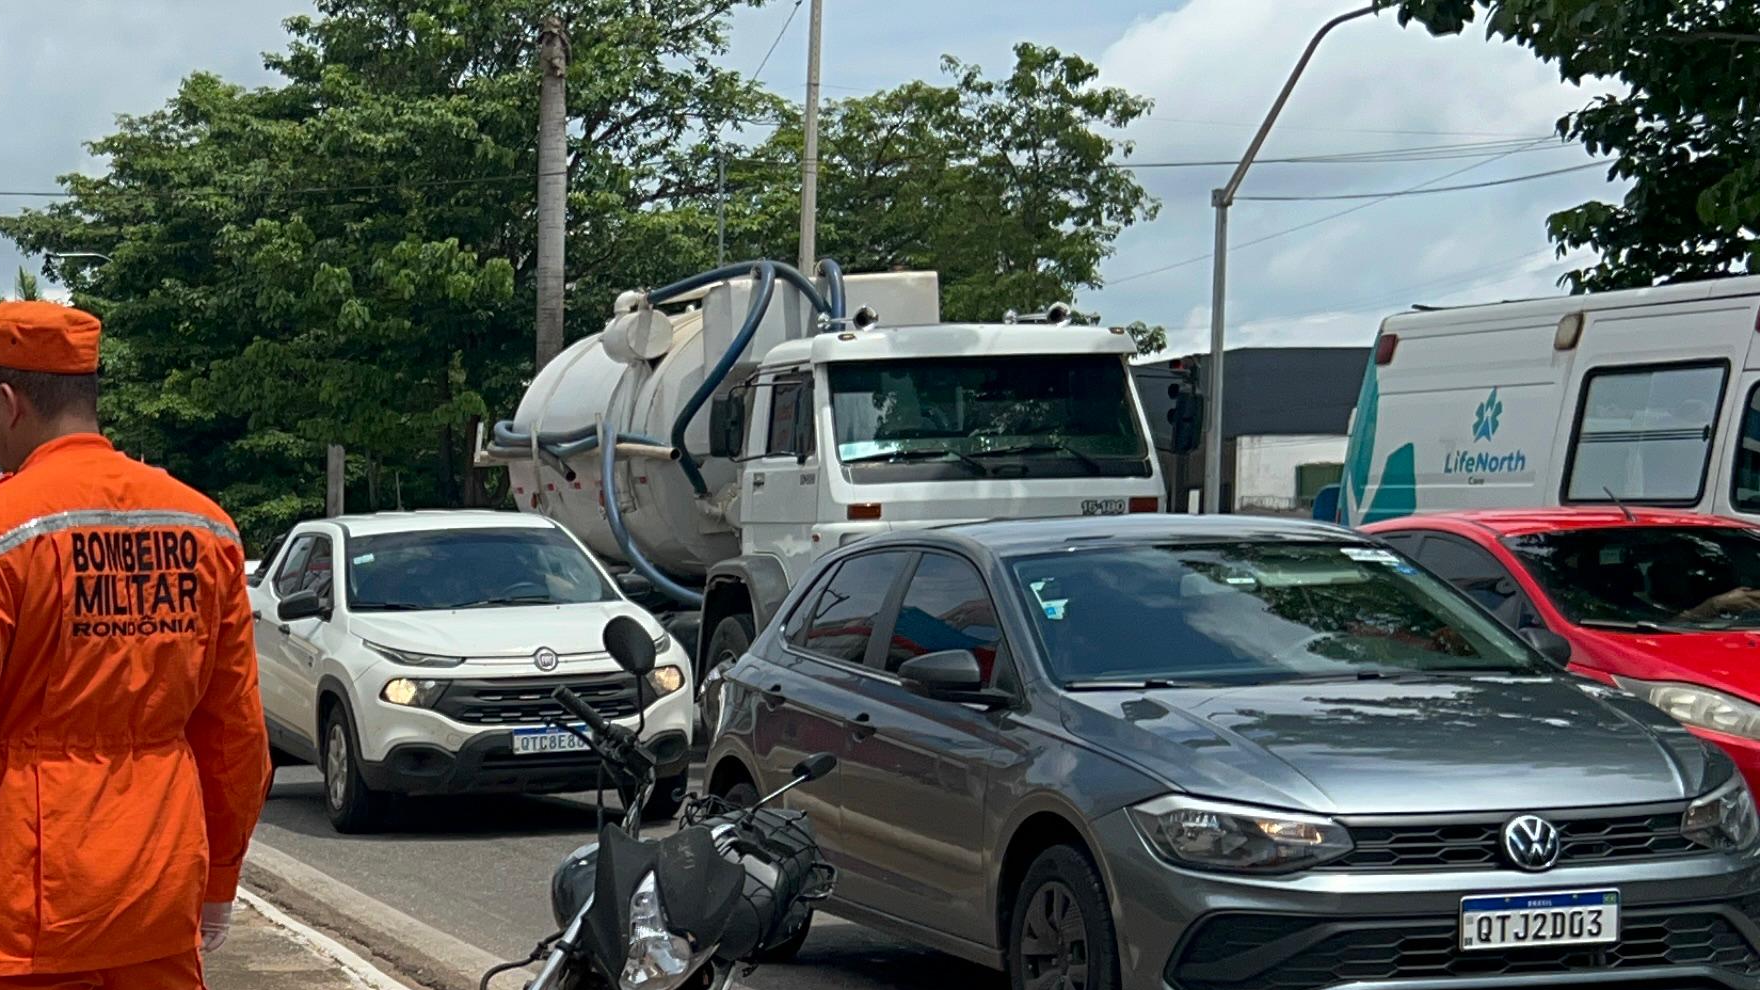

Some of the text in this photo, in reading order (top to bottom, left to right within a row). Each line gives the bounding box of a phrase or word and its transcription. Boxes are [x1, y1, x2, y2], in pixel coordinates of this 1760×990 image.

[1444, 449, 1526, 474] LifeNorth
[71, 530, 199, 573] BOMBEIRO
[74, 572, 198, 617] MILITAR
[72, 614, 196, 637] RONDÔNIA
[1477, 910, 1602, 943] QTJ2D03
